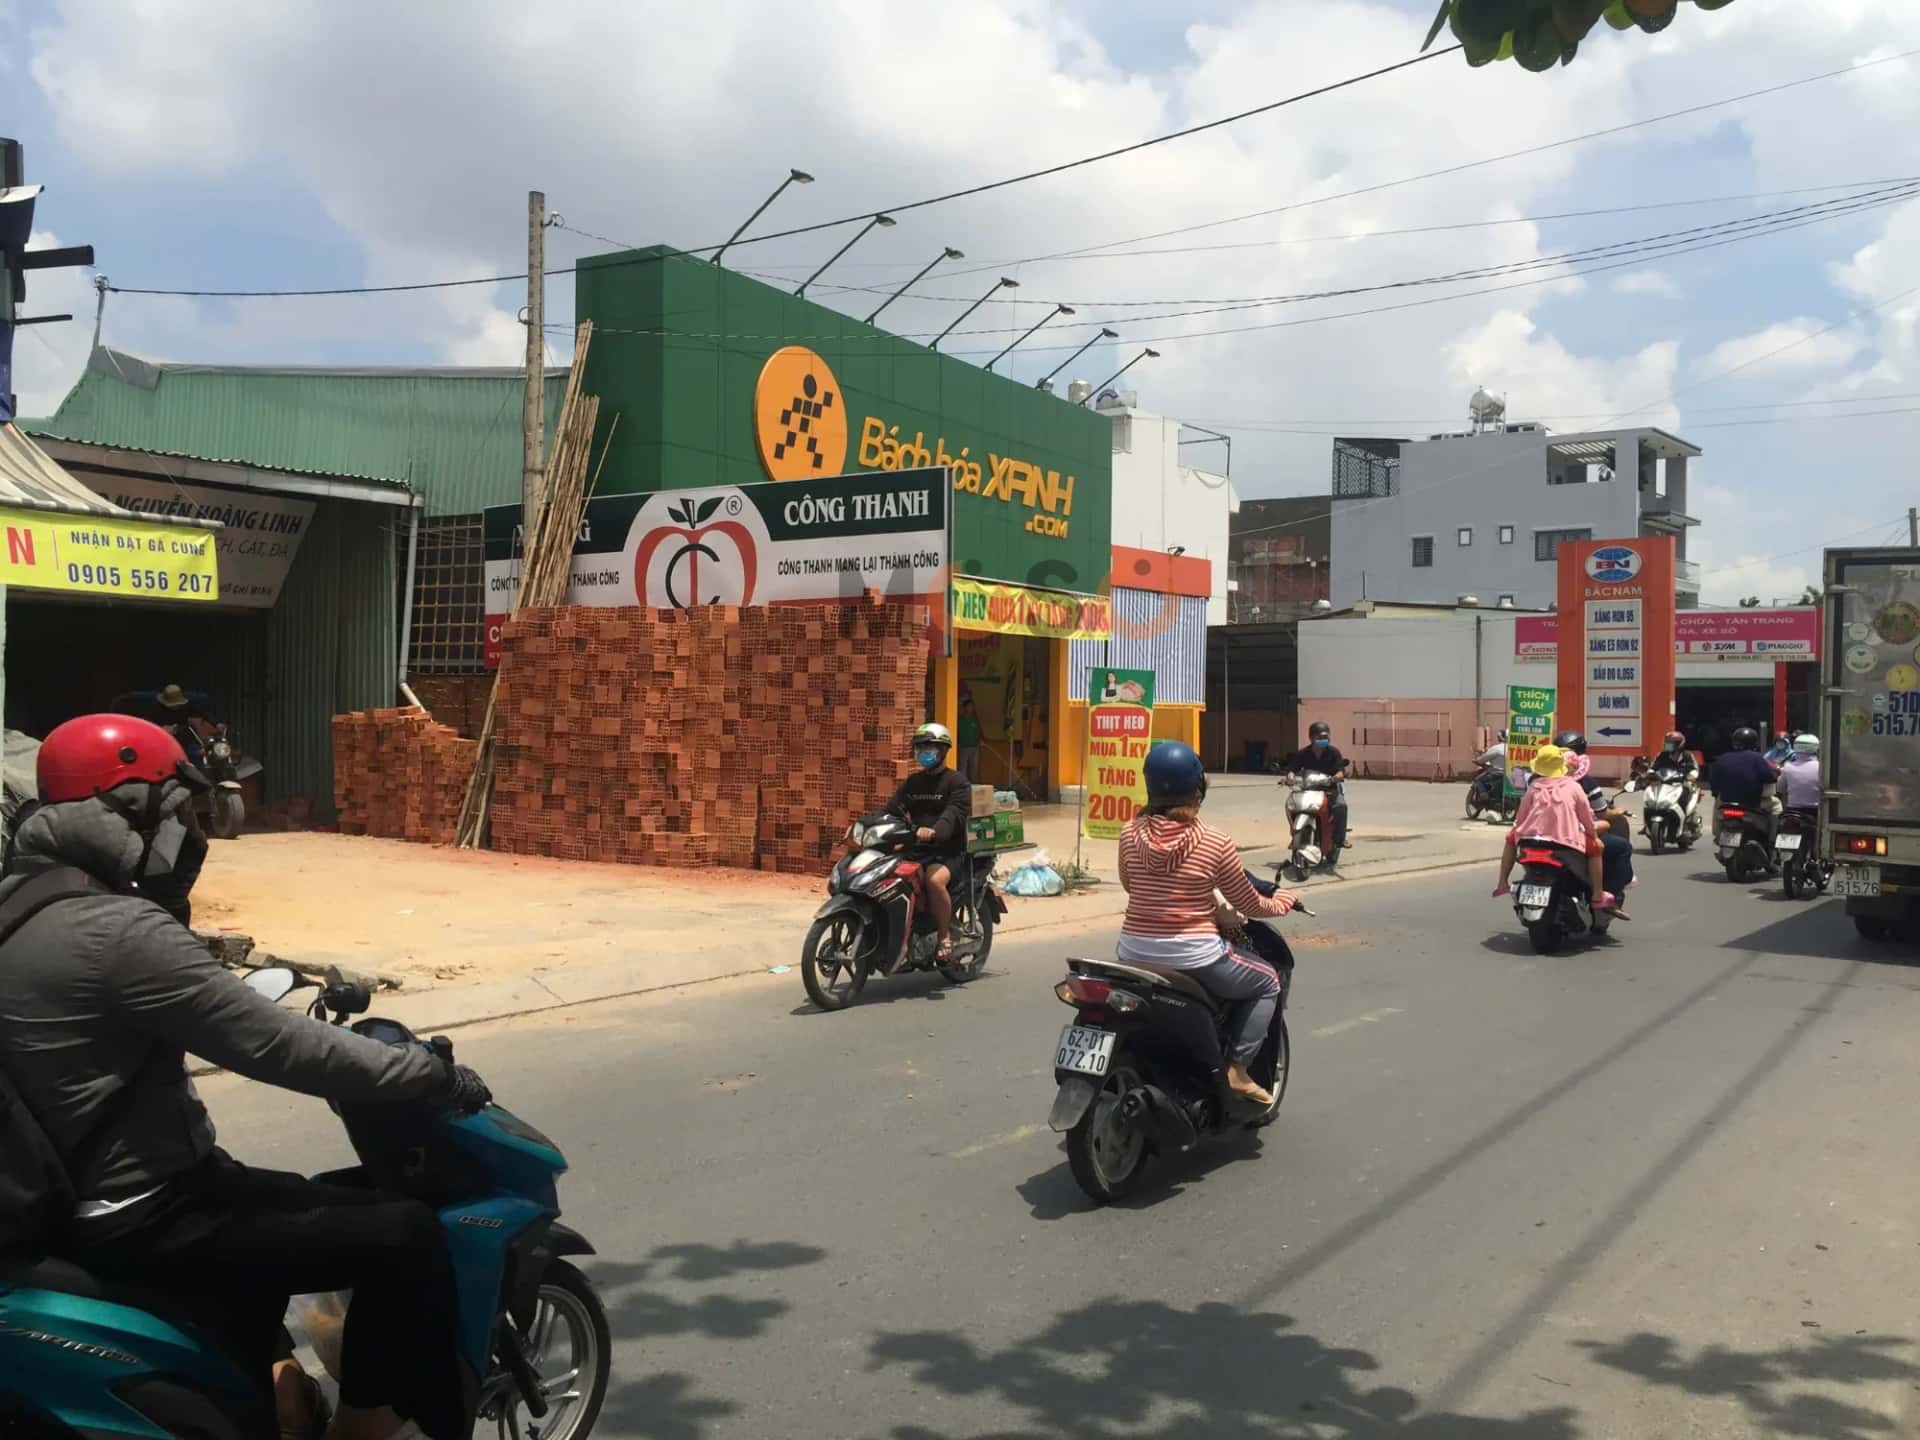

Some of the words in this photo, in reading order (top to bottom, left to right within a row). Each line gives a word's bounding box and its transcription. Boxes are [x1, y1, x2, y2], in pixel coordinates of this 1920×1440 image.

[982, 453, 1075, 516] XANH
[784, 493, 846, 527] CÔNG
[852, 489, 930, 521] THANH
[262, 511, 304, 535] LINH
[778, 557, 802, 577] CÔNG
[803, 556, 833, 574] THANH
[835, 556, 861, 573] MANG
[863, 555, 878, 575] LẠI
[913, 550, 940, 568] CÔNG
[68, 563, 121, 587] 0905
[131, 568, 170, 591] 556
[178, 573, 213, 594] 207
[963, 591, 987, 621] HEO
[1096, 715, 1121, 732] THỊT
[1123, 715, 1145, 730] HEO
[1090, 741, 1117, 757] MUA
[1057, 1047, 1106, 1073] 072.10
